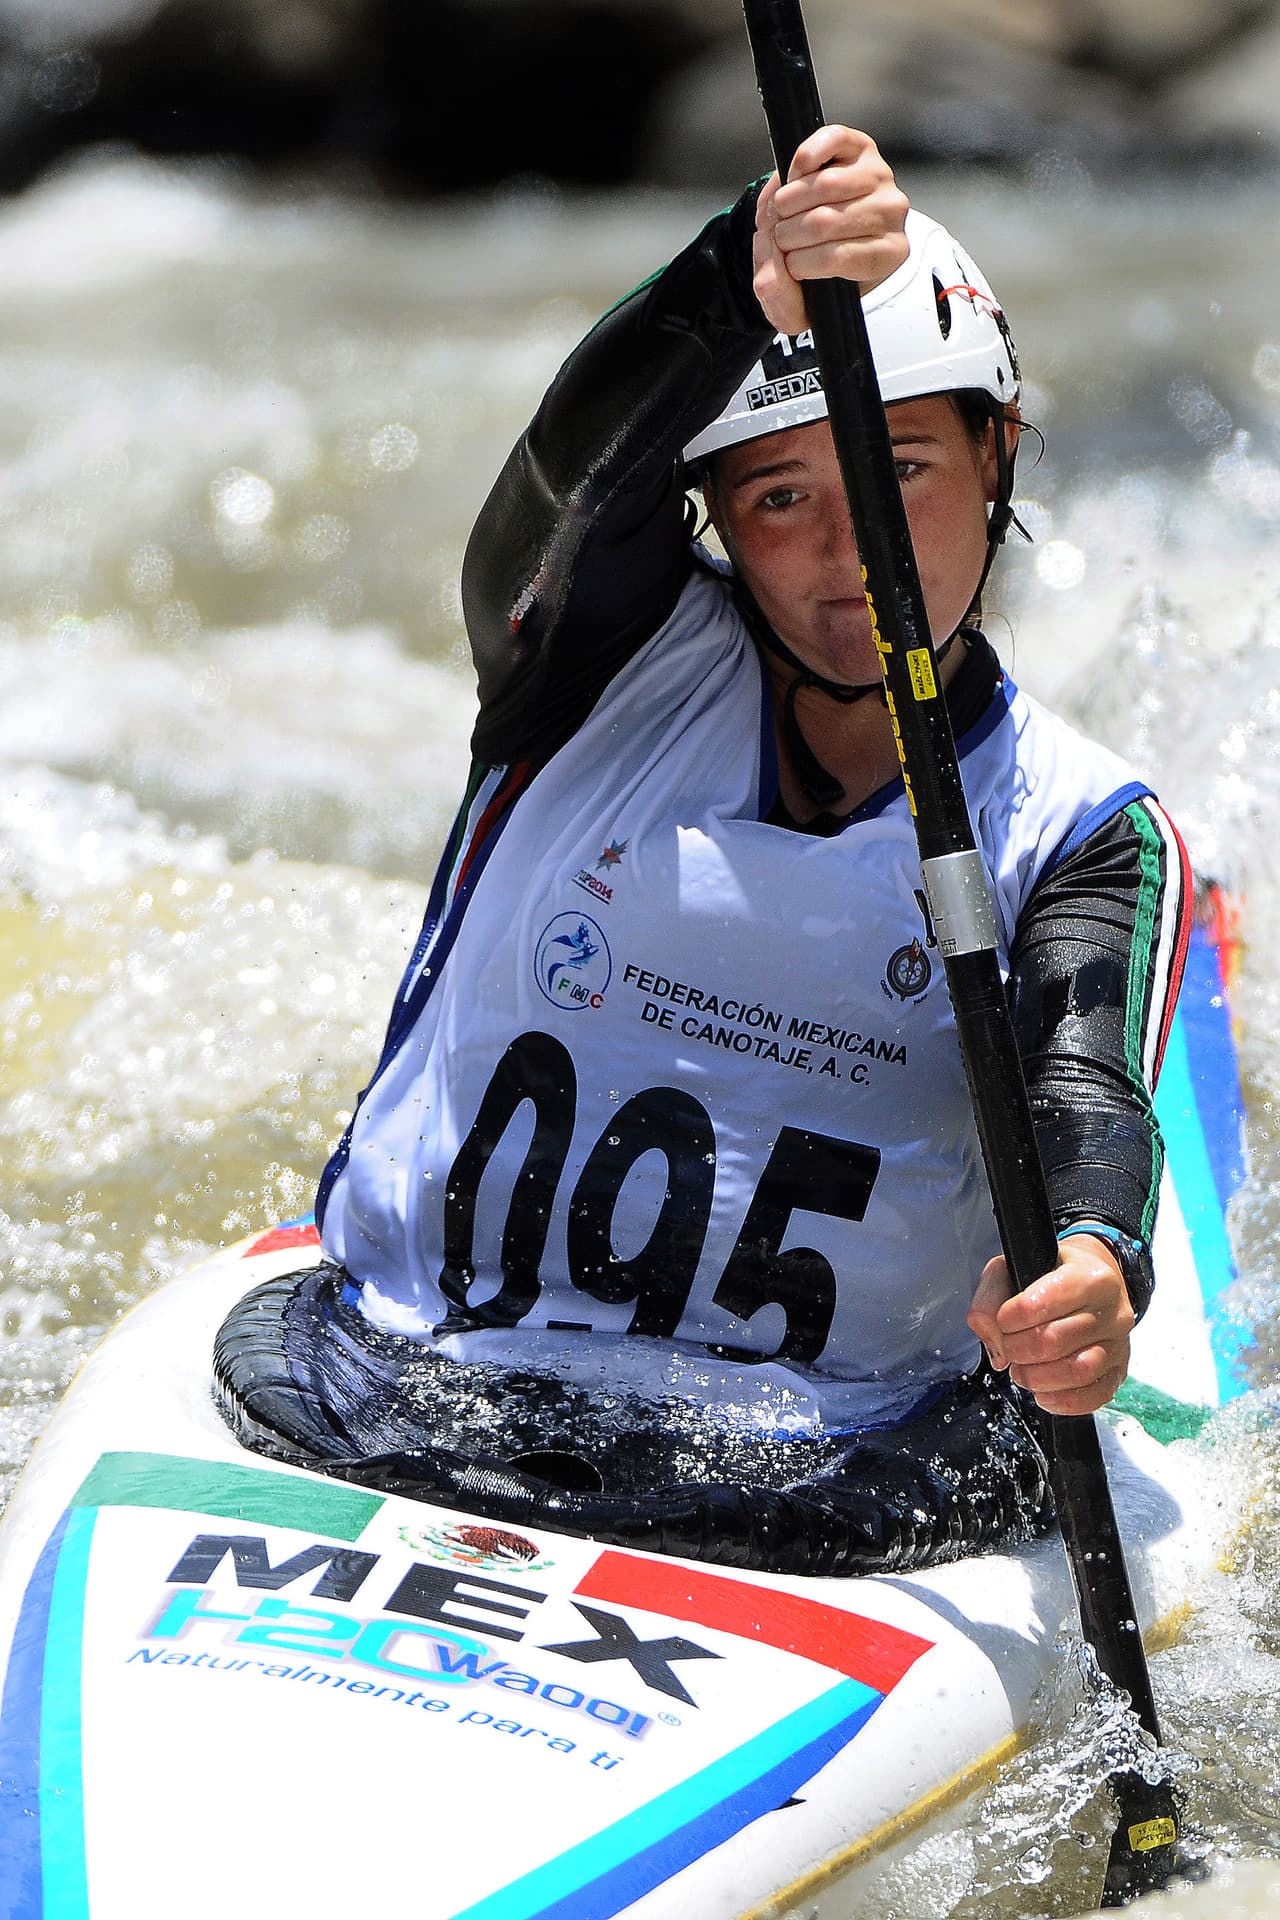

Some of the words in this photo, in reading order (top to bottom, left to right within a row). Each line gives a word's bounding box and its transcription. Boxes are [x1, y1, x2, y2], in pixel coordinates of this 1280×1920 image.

[748, 370, 821, 409] PREDA
[622, 964, 783, 1033] FEDERACIÓN
[786, 1017, 908, 1066] MEXICANA
[641, 1001, 676, 1031] DE
[680, 1016, 814, 1075] CANOTAJE,
[818, 1056, 842, 1079] A.
[850, 1063, 871, 1086] C.
[434, 1030, 882, 1364] 095
[166, 1533, 727, 1709] MEX
[125, 1647, 452, 1715] Naturalmente
[458, 1709, 576, 1755] para
[588, 1747, 626, 1772] ti
